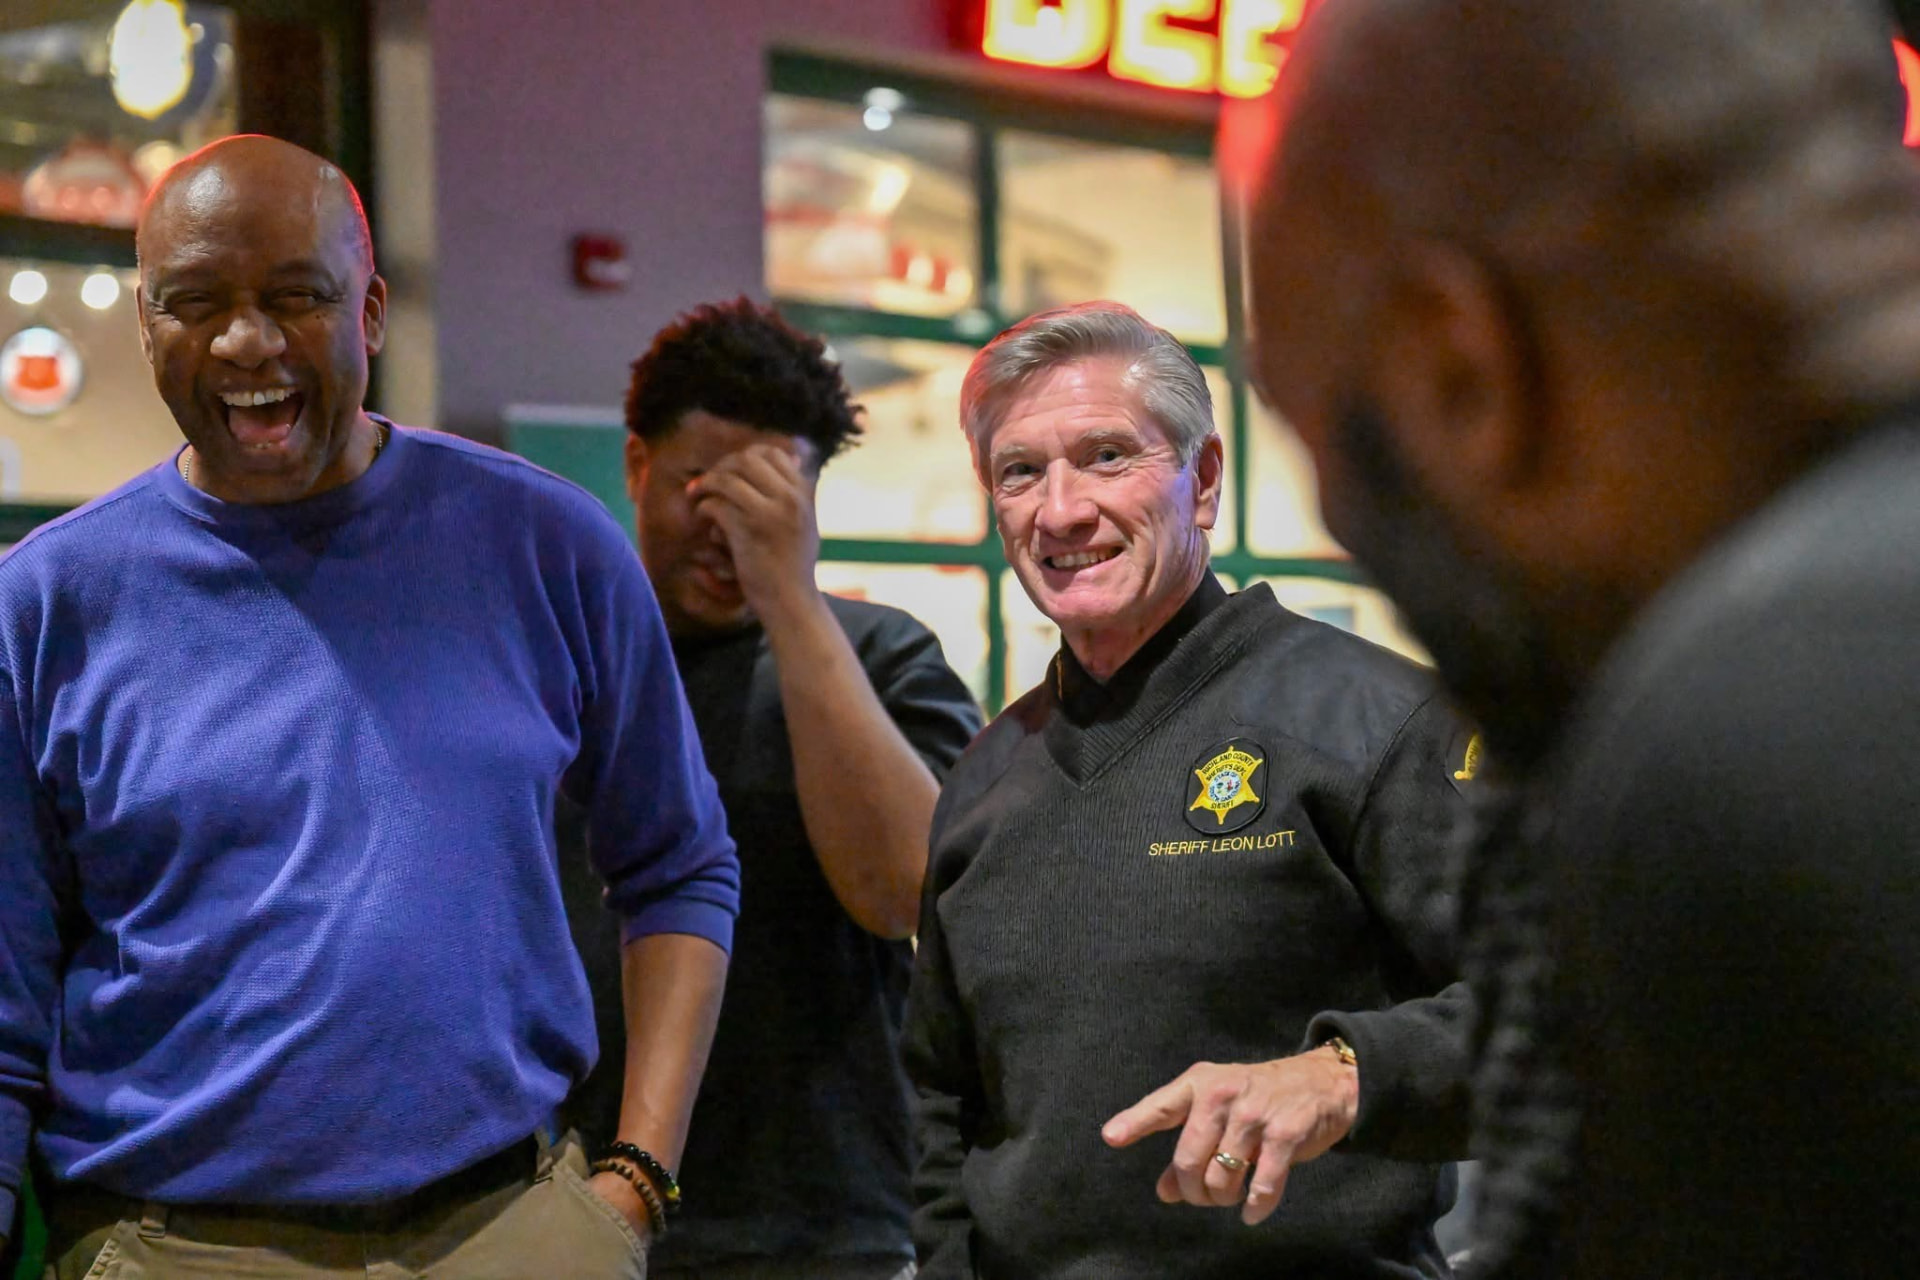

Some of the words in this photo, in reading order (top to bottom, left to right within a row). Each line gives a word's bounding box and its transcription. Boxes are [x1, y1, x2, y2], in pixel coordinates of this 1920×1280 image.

[1202, 753, 1232, 774] RICHLAND
[1233, 753, 1254, 767] COUNTY
[1149, 840, 1210, 856] SHERIFF
[1212, 836, 1254, 853] LEON
[1257, 830, 1296, 849] LOTT
